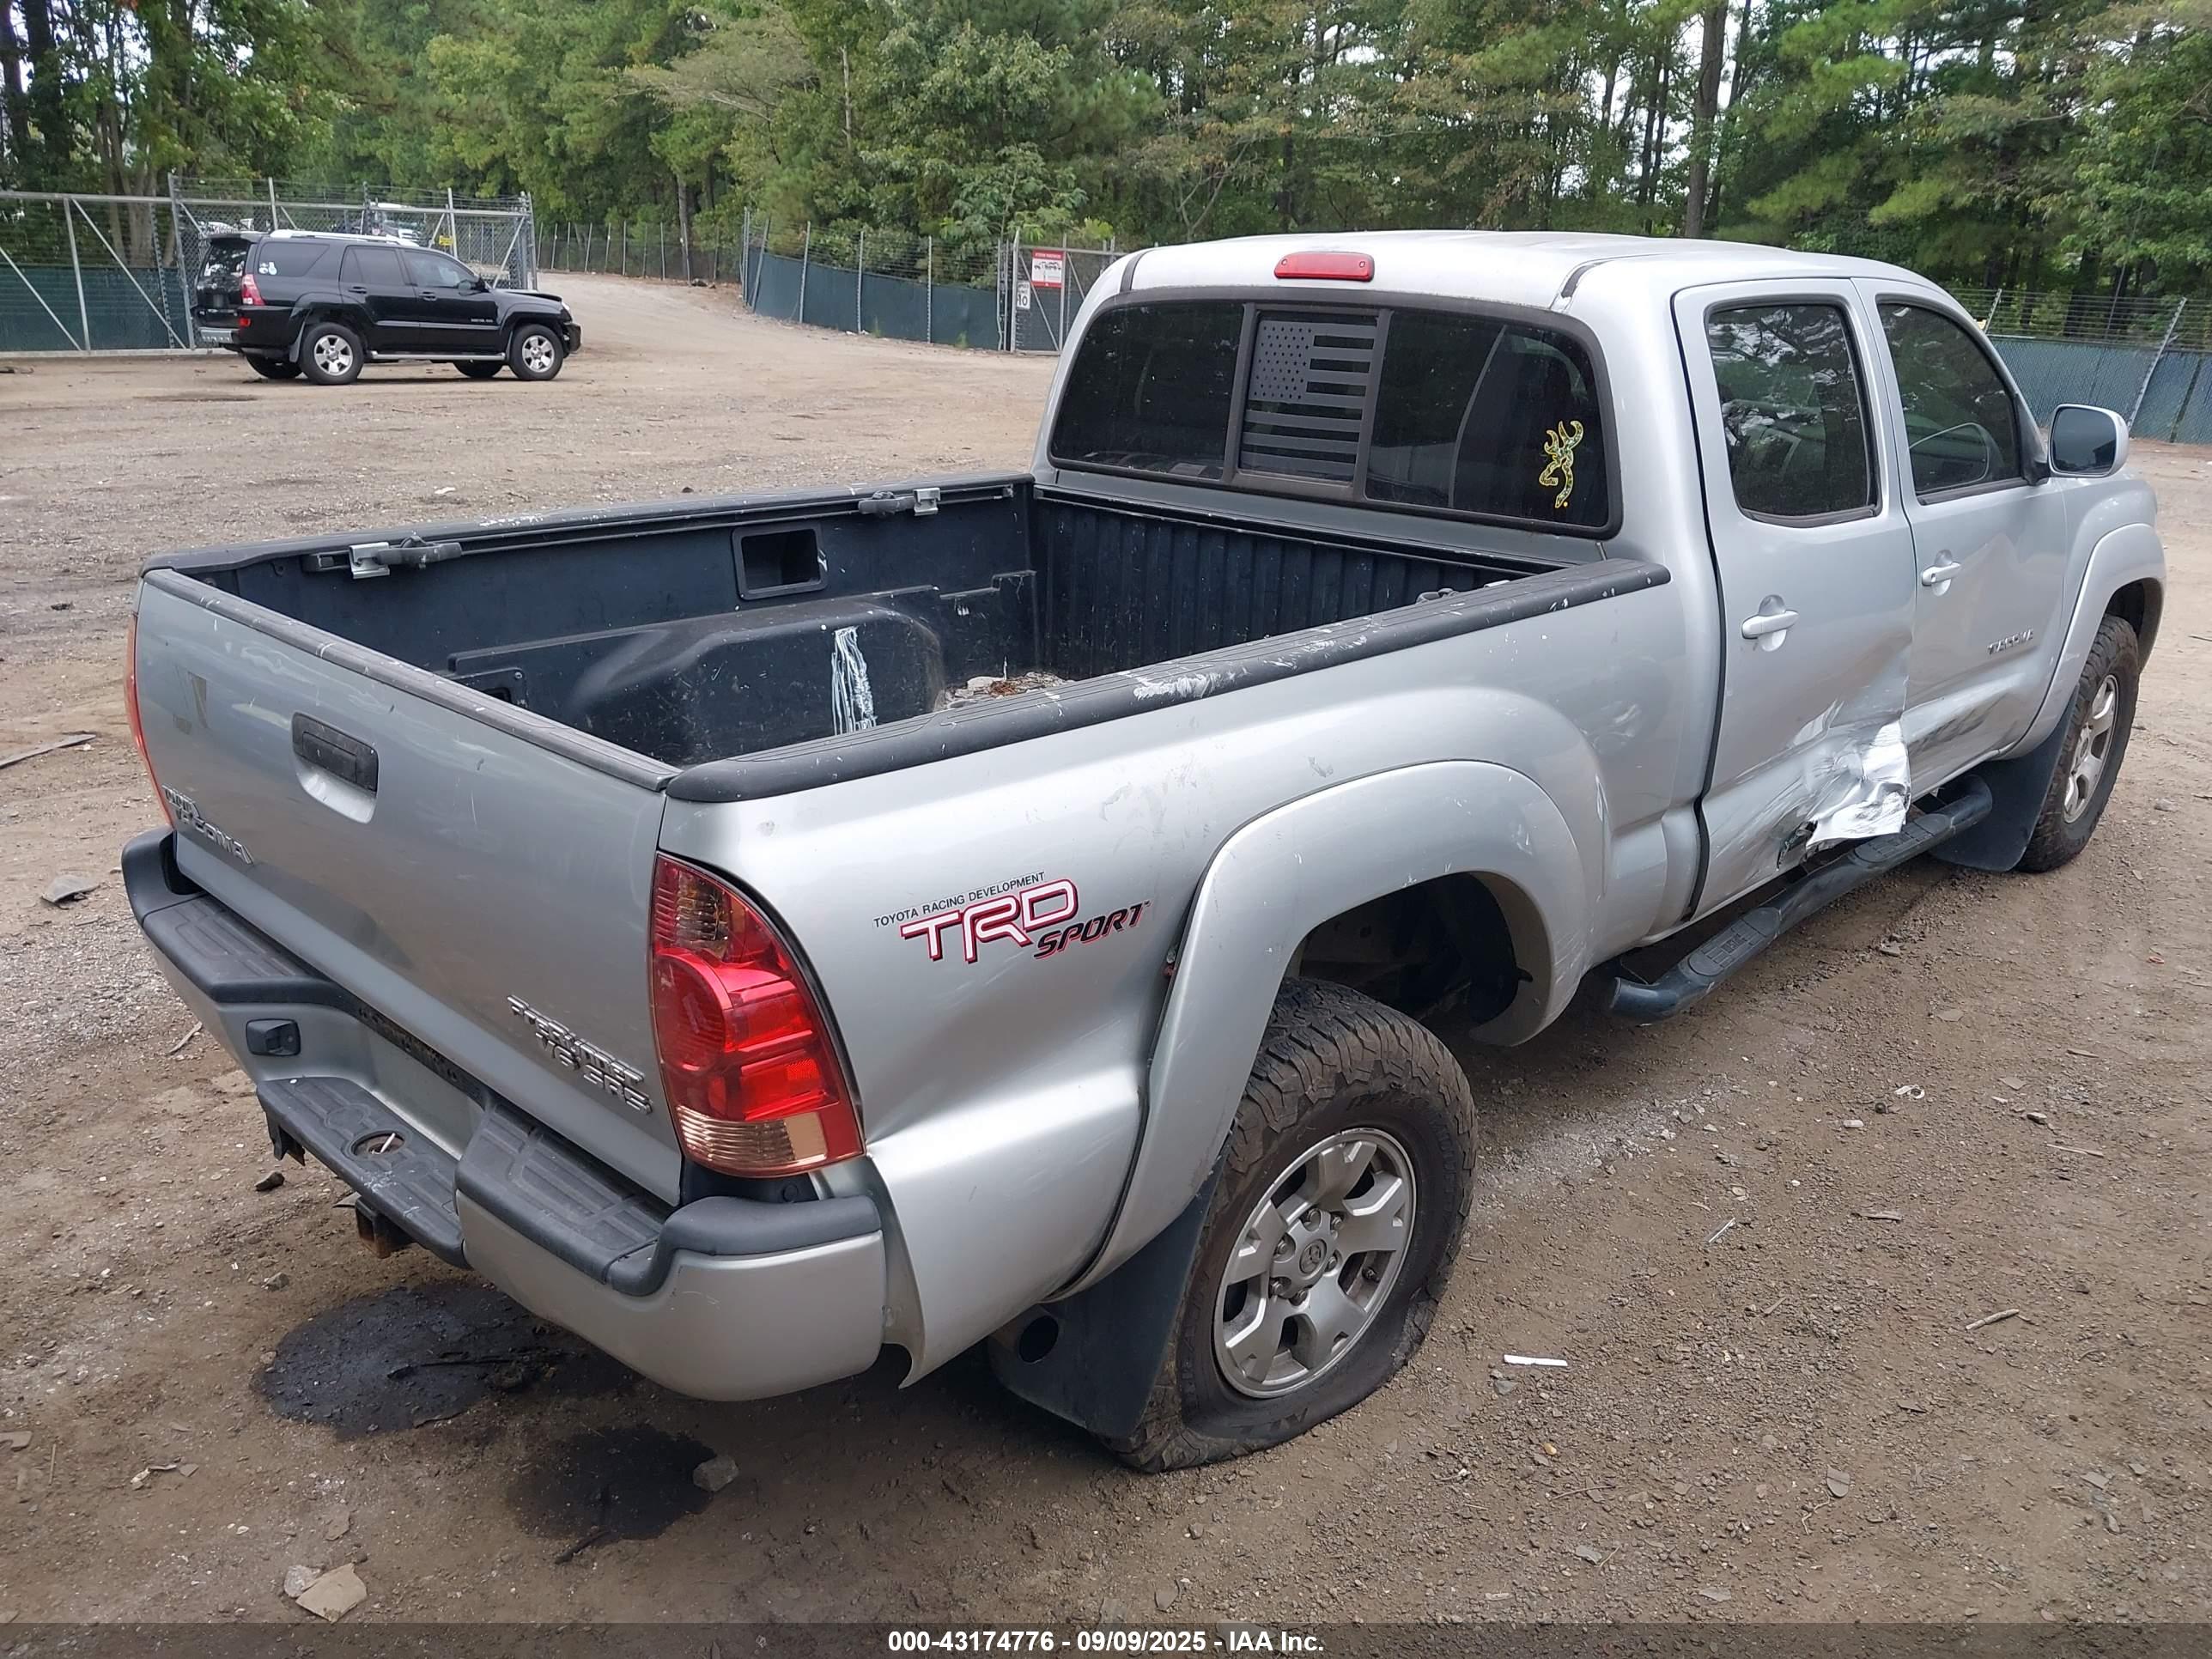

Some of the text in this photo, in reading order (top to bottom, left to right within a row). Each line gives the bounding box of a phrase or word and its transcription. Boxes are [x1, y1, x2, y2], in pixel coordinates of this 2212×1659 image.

[1018, 294, 1028, 306] 10
[873, 872, 1045, 928] TOYOTA RACING DEVELOPMENT
[899, 878, 1079, 963] TRD
[1033, 902, 1146, 959] SPORT
